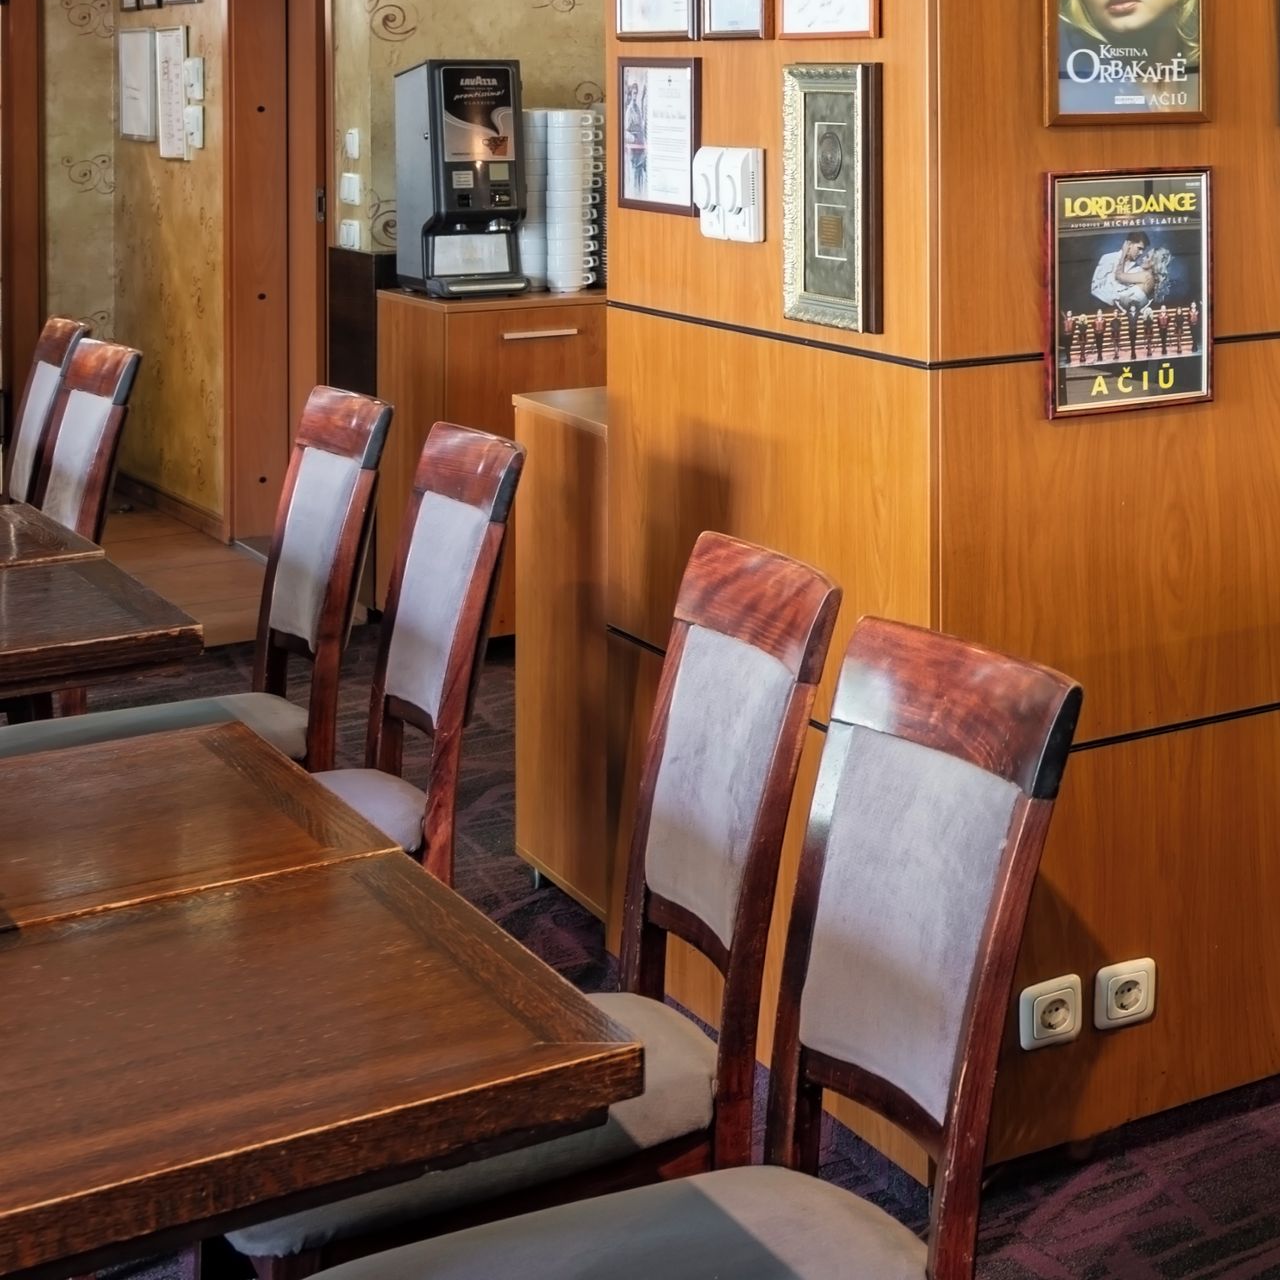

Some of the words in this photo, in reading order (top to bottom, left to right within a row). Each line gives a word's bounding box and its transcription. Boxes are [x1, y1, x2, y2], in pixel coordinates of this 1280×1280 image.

[1066, 50, 1188, 84] ORBAKAITĖ
[459, 76, 498, 86] LAVAZZA
[1148, 92, 1188, 107] AČIŪ
[1064, 195, 1117, 218] LORD
[1116, 195, 1132, 205] OF
[1132, 192, 1197, 214] DANCE
[1115, 204, 1132, 215] THE
[1103, 218, 1147, 228] MICHAEL
[1150, 216, 1190, 225] FLATLEY
[1090, 362, 1176, 397] AČIŪ
